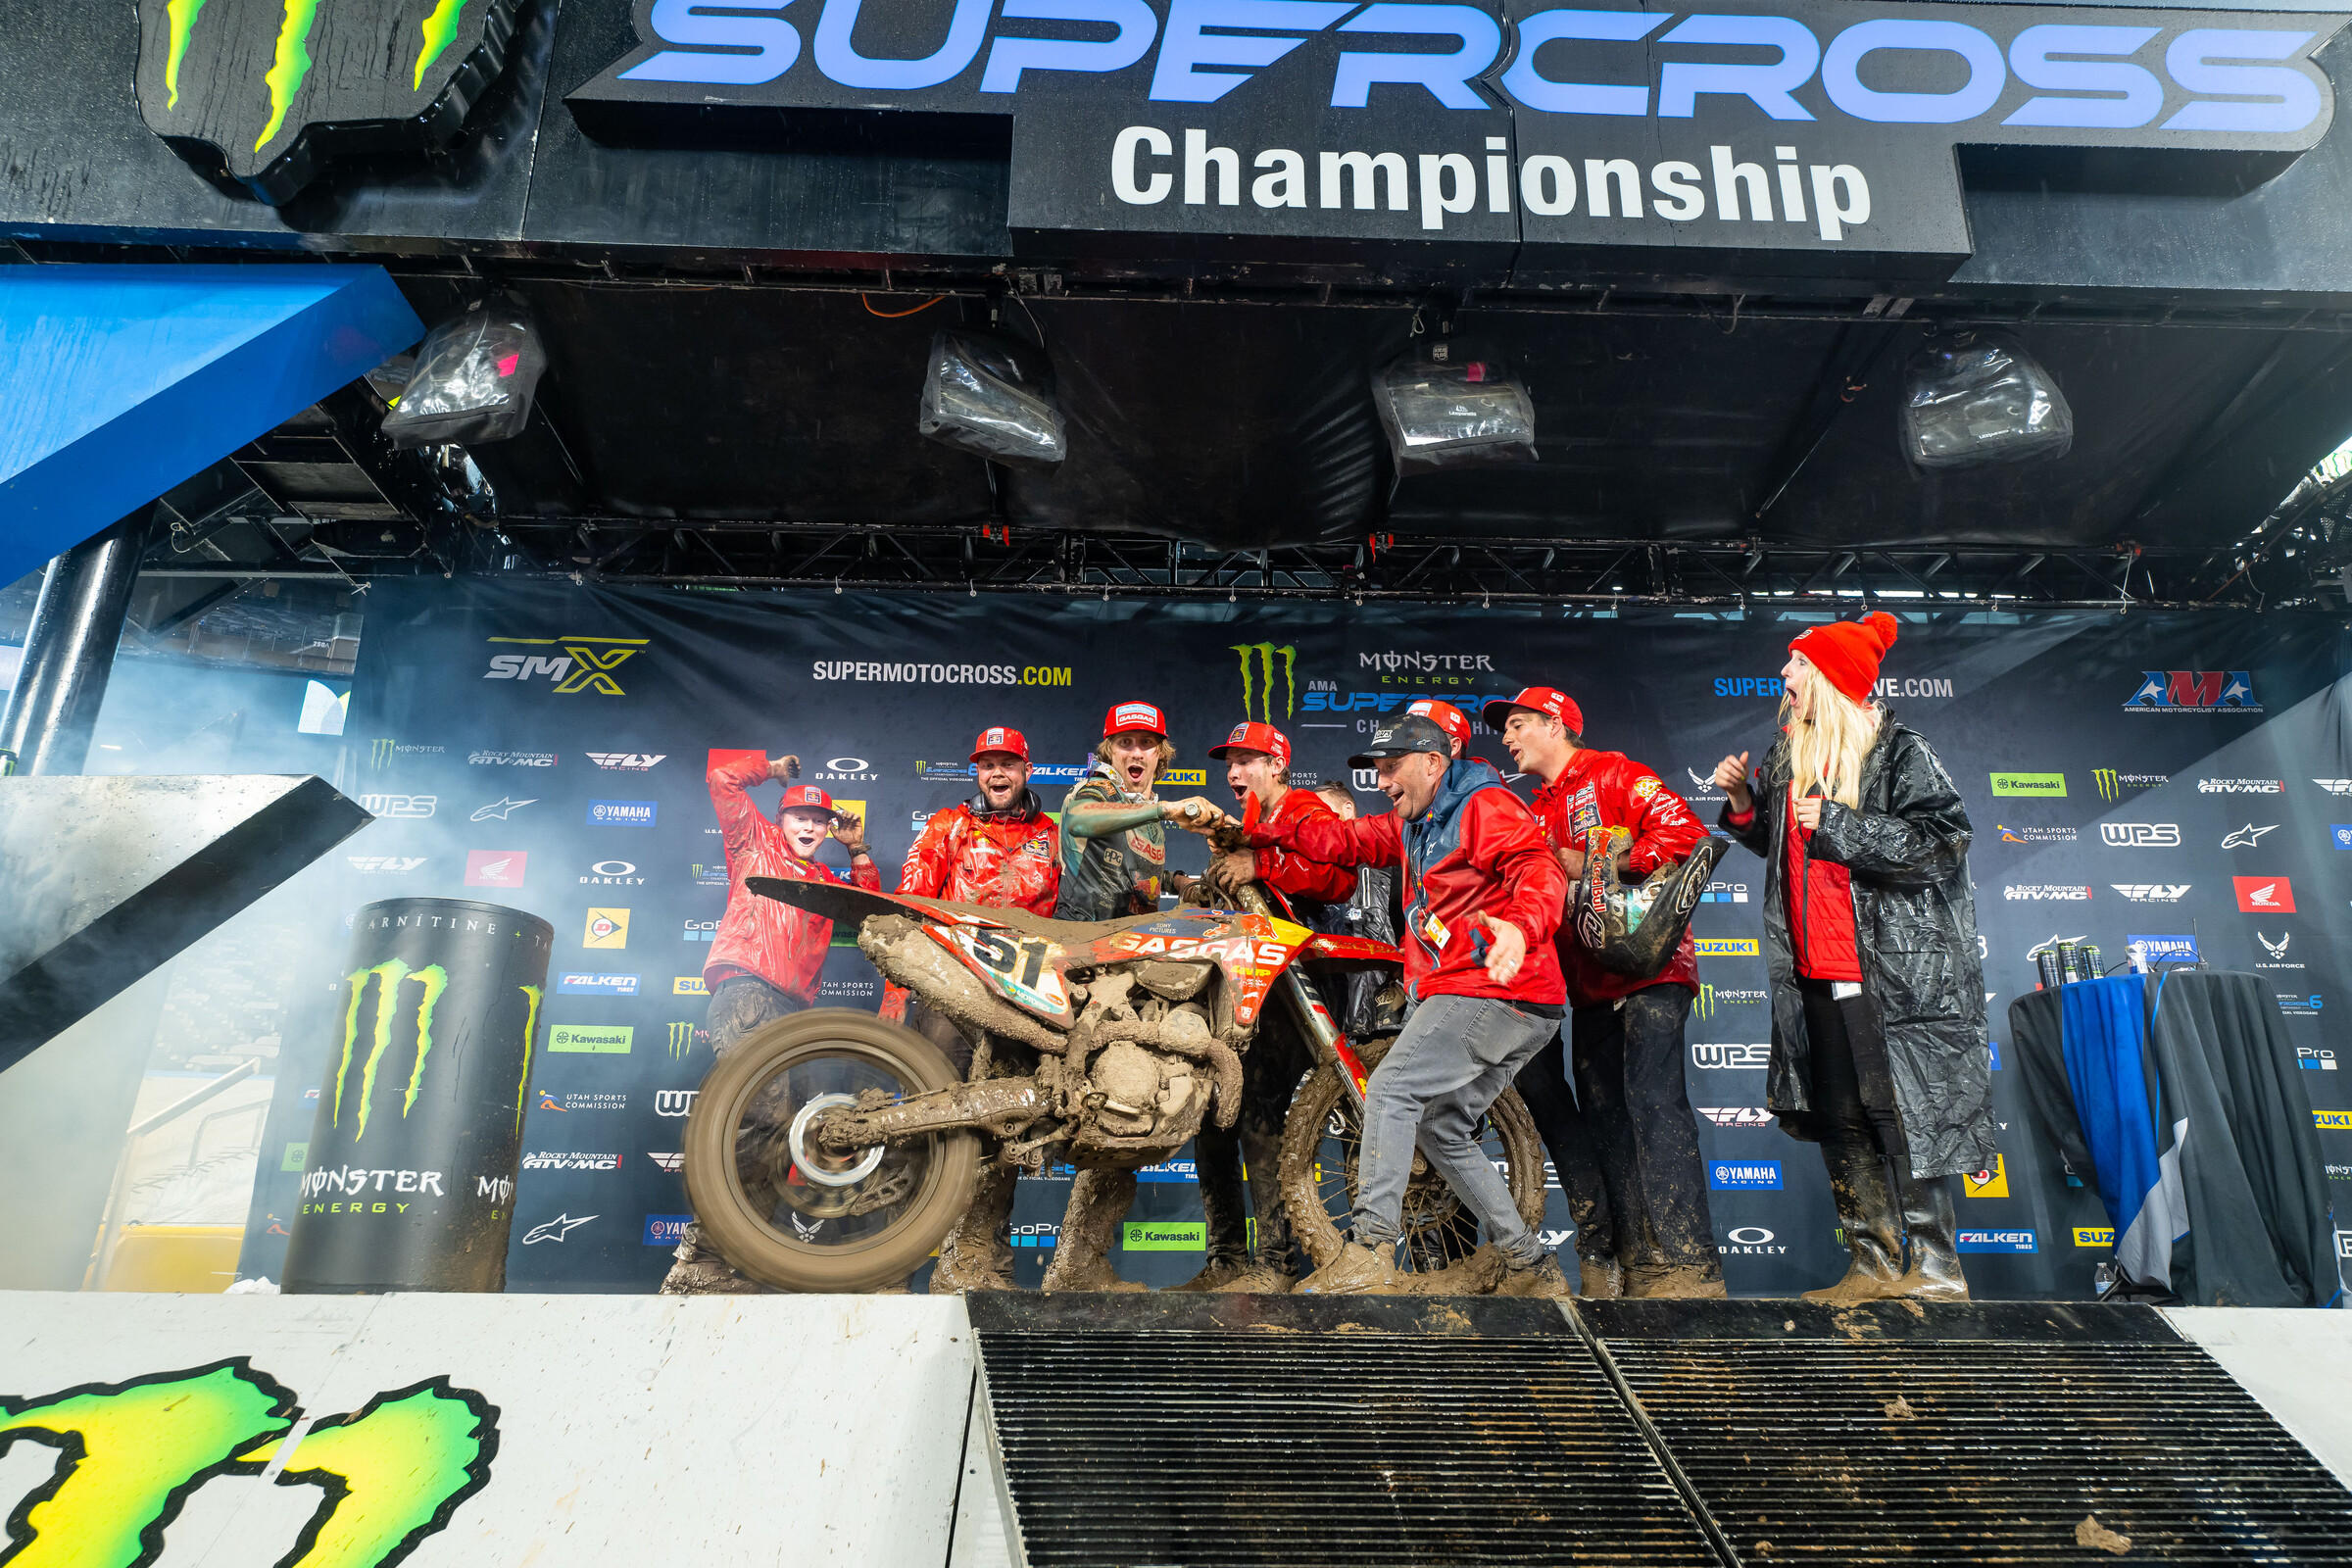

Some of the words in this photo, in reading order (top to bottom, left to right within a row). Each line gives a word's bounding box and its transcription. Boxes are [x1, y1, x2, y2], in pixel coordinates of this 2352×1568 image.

[616, 0, 2322, 132] SUPERCROSS
[1111, 126, 1871, 241] Championship
[1359, 650, 1495, 672] MONSTER
[483, 647, 638, 696] SMX
[812, 661, 1072, 686] SUPERMOTOCROSS.COM
[1308, 681, 1338, 691] AMA
[1382, 675, 1475, 685] ENERGY
[2122, 671, 2263, 707] AMA
[1119, 714, 1154, 723] GASGAS
[395, 745, 445, 754] MONSTER
[585, 753, 667, 767] FLY
[815, 772, 879, 781] OAKLEY
[1156, 772, 1200, 782] ZUKI
[2119, 774, 2169, 783] MONSTER
[2011, 780, 2060, 789] Kawasaki
[607, 807, 651, 817] YAMAHA
[2100, 823, 2180, 847] WPS
[347, 857, 428, 871] FLY
[579, 876, 645, 885] OAKLEY
[2110, 884, 2192, 899] FLY
[1108, 931, 1287, 965] GASGAS
[2147, 941, 2192, 952] YAMAHA
[564, 975, 637, 986] FALKEN
[1716, 990, 1767, 999] MONSTER
[1016, 990, 1052, 1013] MOTOREX
[2309, 994, 2324, 1009] 6
[571, 1034, 626, 1045] Kawasaki
[1691, 1044, 1771, 1069] WPS
[2313, 1114, 2350, 1125] ZUKI
[1729, 1166, 1777, 1180] YAMAHA
[300, 1164, 445, 1199] MONSTER
[303, 1202, 410, 1215] ENERGY
[1146, 1232, 1200, 1242] Kawasaki
[1959, 1233, 2033, 1243] FALKEN
